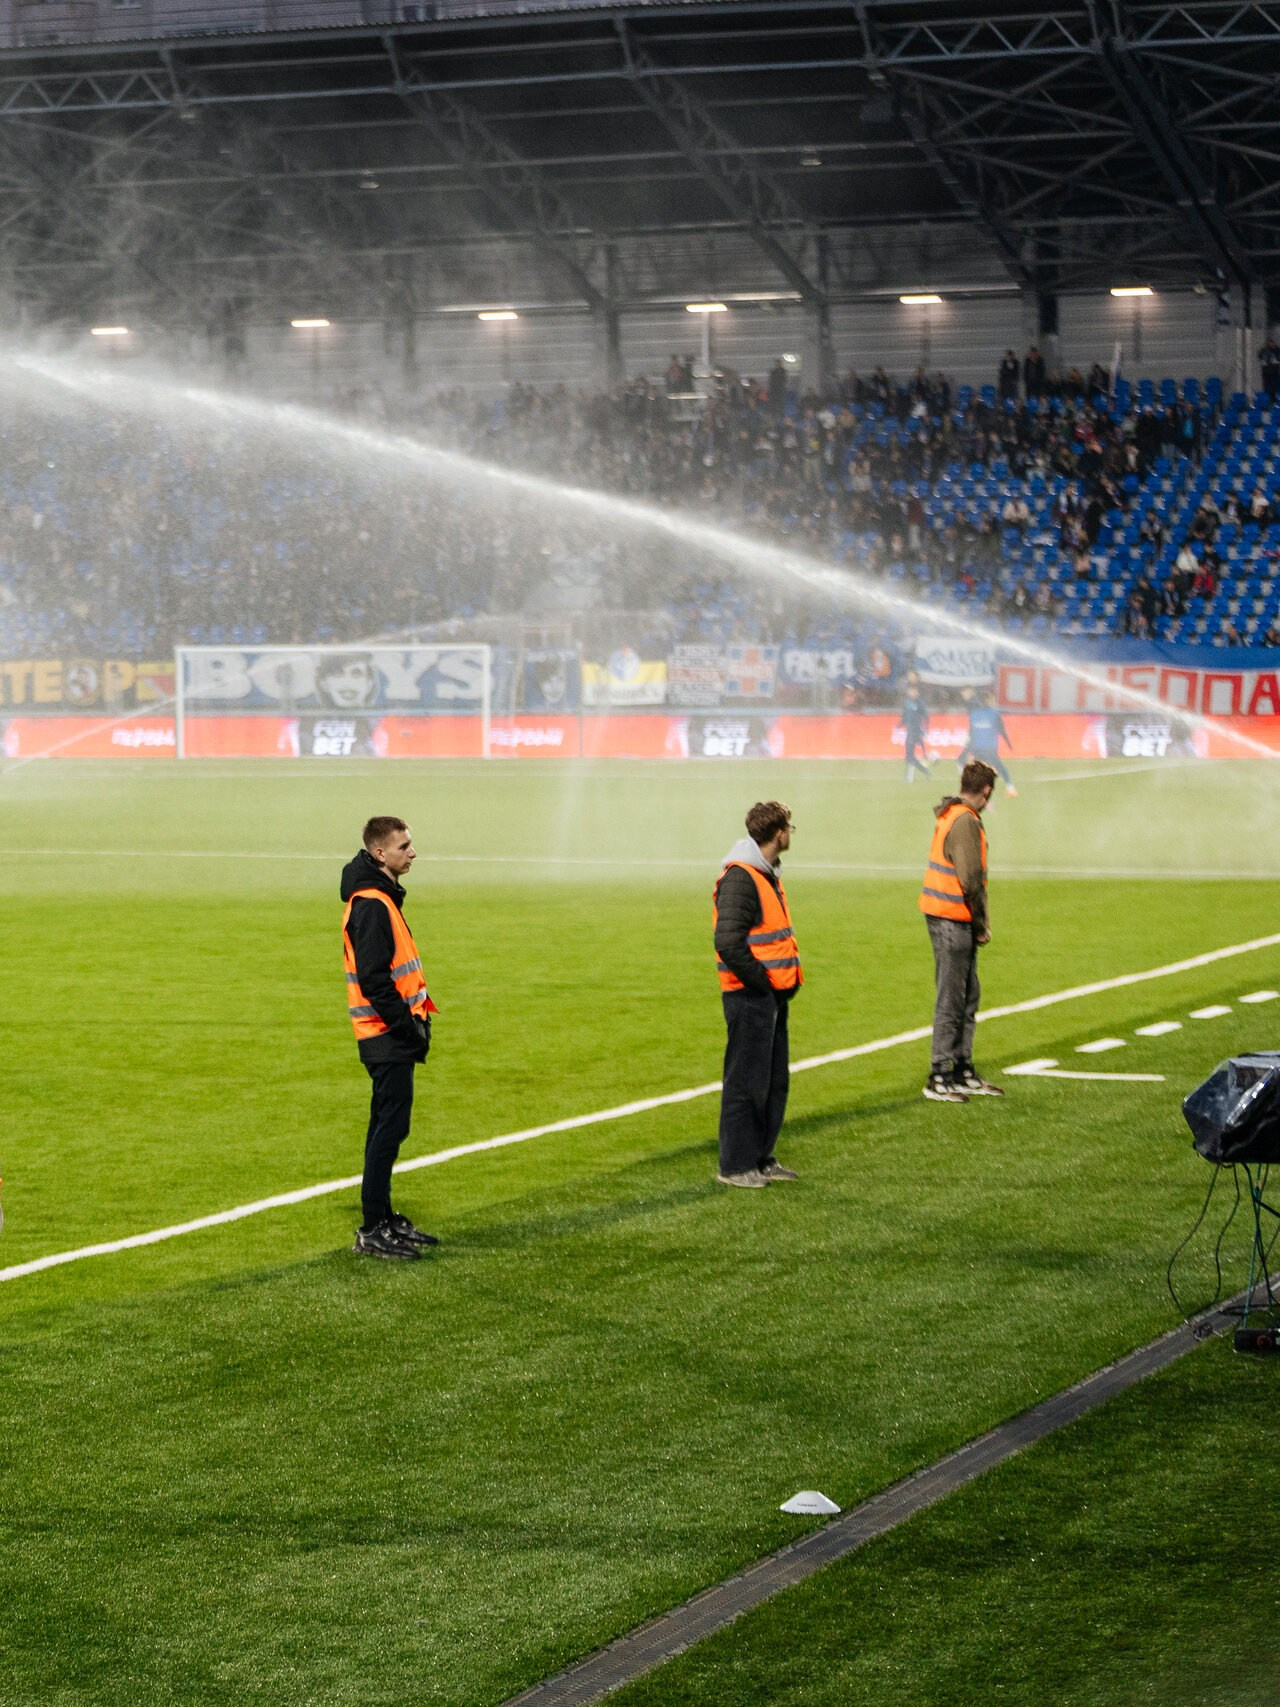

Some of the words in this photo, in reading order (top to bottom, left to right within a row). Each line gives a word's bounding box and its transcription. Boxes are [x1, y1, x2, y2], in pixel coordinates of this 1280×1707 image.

[184, 651, 494, 701] BOYS
[313, 720, 356, 738] FON
[313, 737, 357, 756] BET
[703, 737, 751, 756] BET
[1121, 737, 1173, 757] BET
